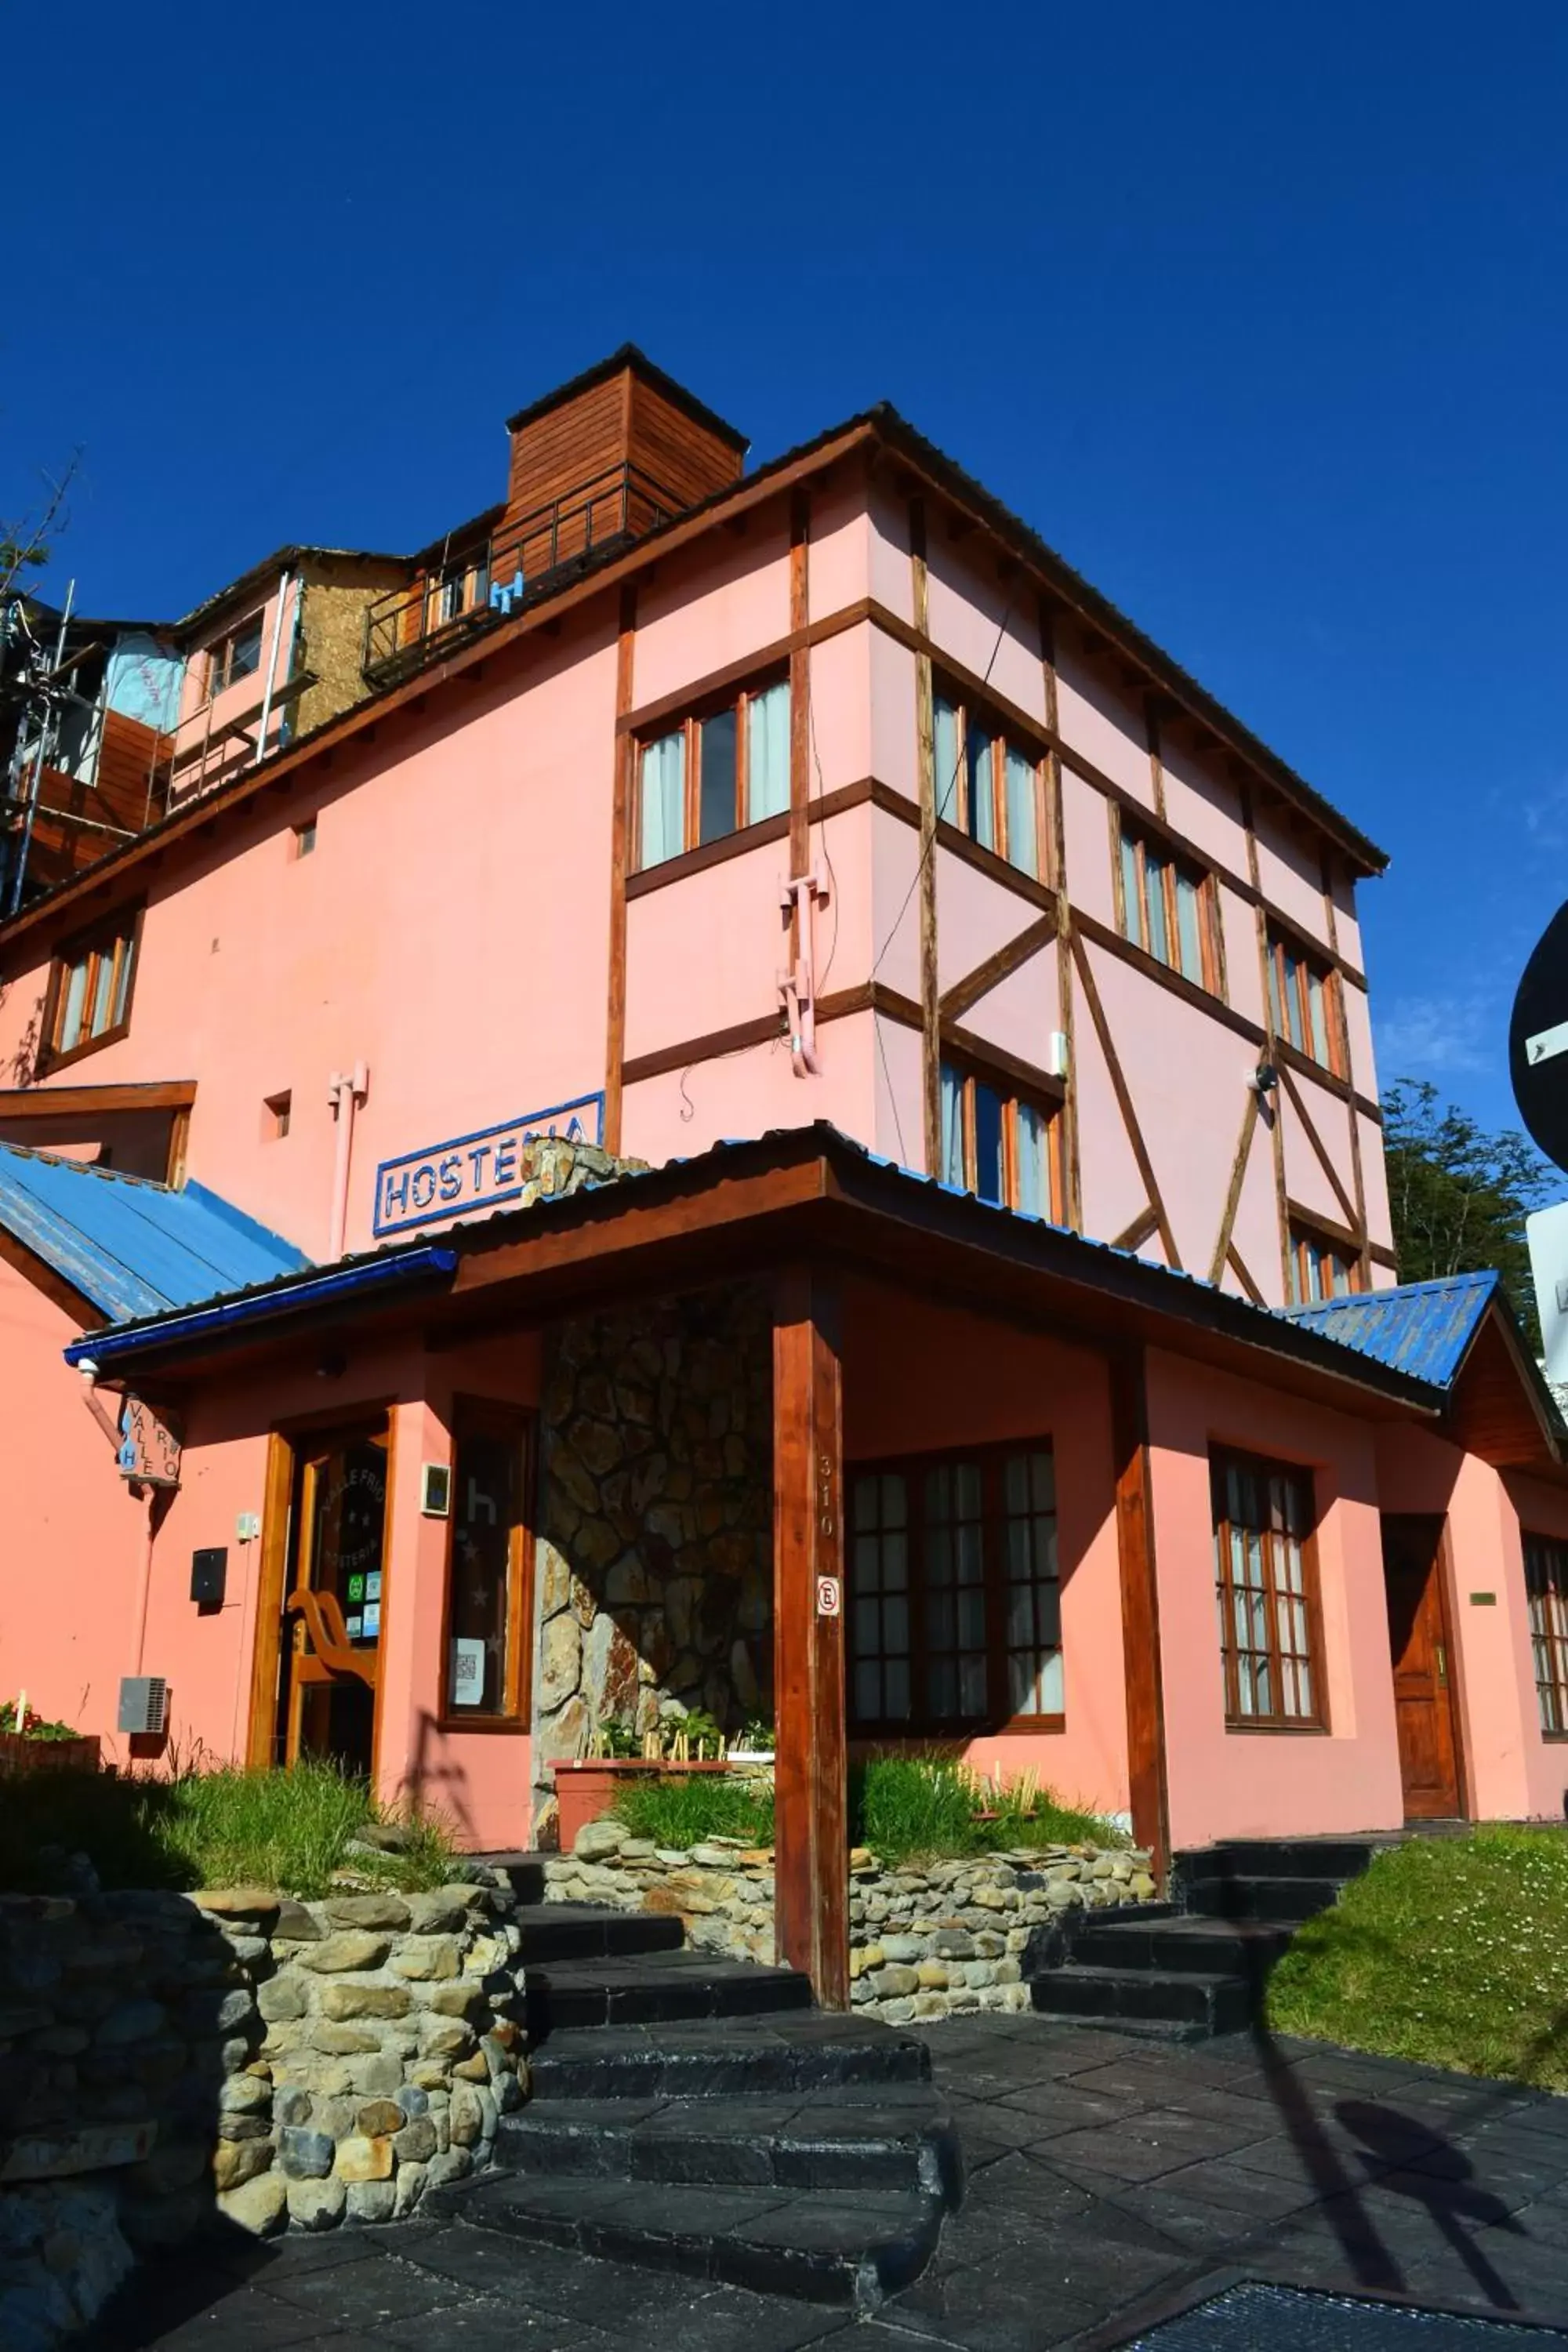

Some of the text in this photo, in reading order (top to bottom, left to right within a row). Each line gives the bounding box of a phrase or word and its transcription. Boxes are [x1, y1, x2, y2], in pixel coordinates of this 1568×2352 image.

[385, 1116, 588, 1218] HOSTEA
[125, 1449, 135, 1465] H
[129, 1403, 153, 1475] VALLE
[359, 1468, 384, 1503] FRIO
[821, 1457, 831, 1535] 310
[823, 1588, 833, 1605] E
